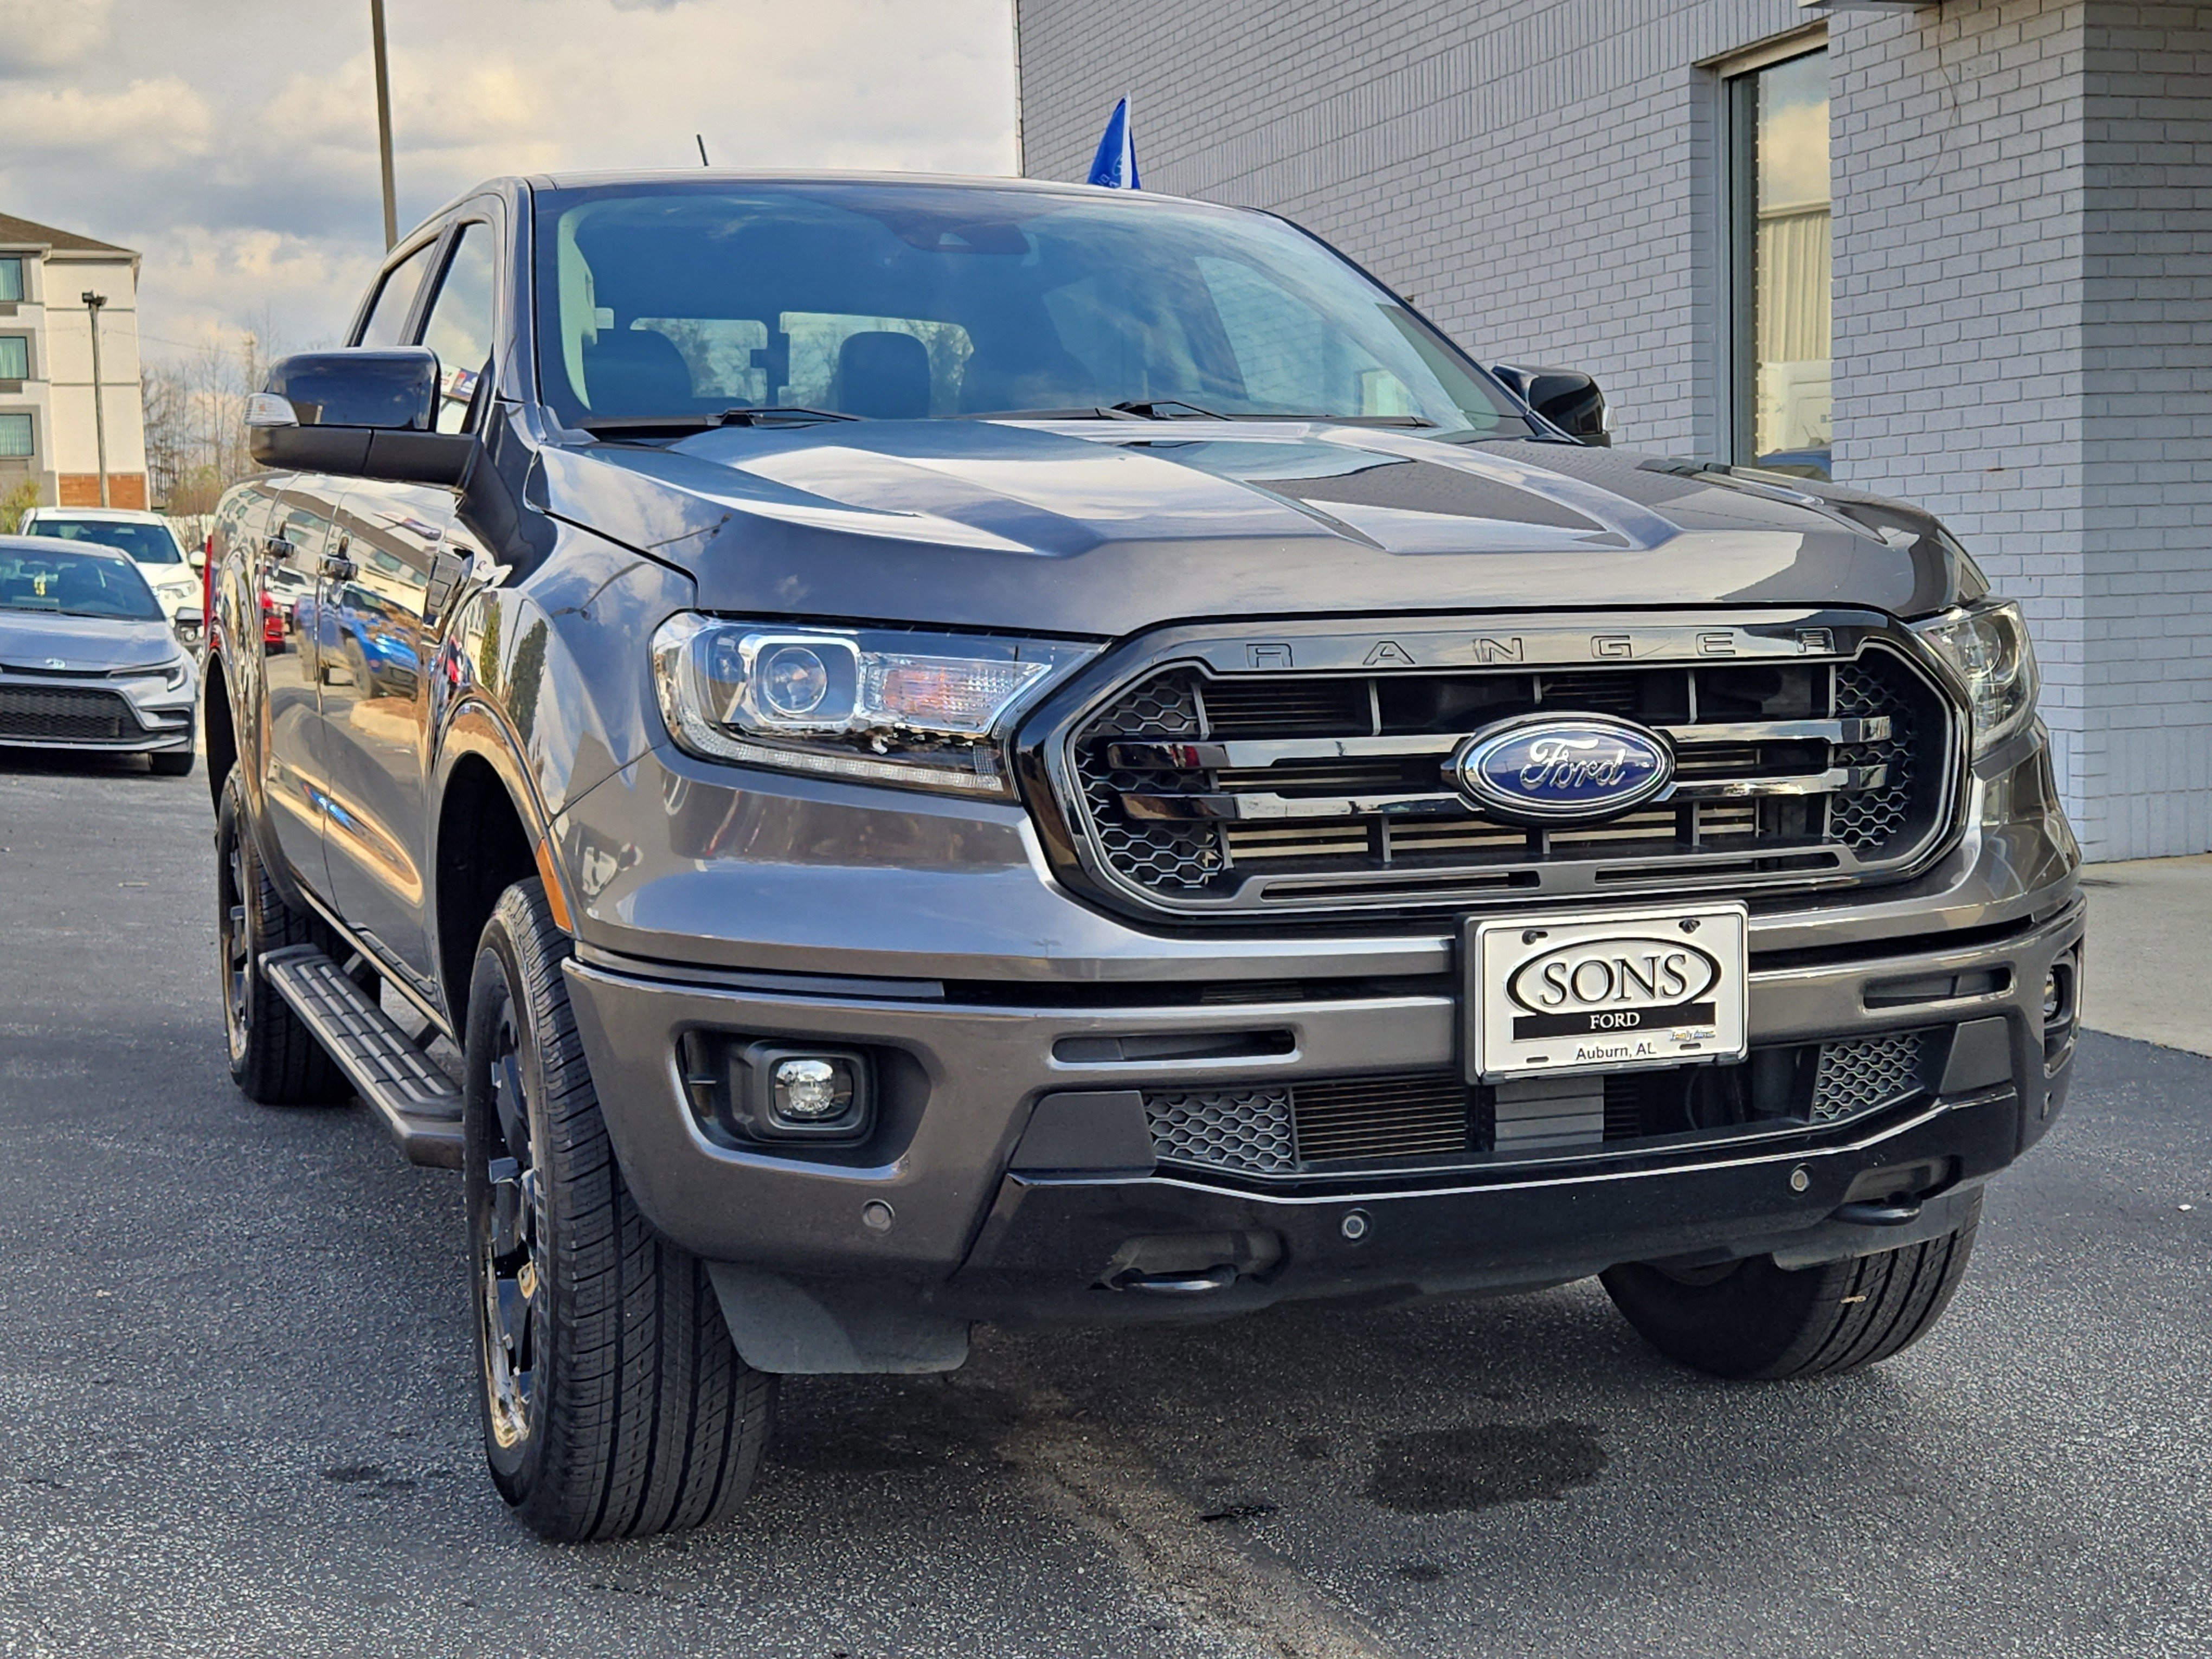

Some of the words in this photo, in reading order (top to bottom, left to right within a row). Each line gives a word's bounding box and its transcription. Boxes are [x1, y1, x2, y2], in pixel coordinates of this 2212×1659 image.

[1246, 627, 1837, 668] RANGER
[1520, 738, 1626, 790] Ford
[1539, 954, 1687, 1007] SONS
[1590, 1012, 1641, 1030] FORD
[1576, 1046, 1632, 1061] Auburn,
[1636, 1041, 1657, 1056] AL
